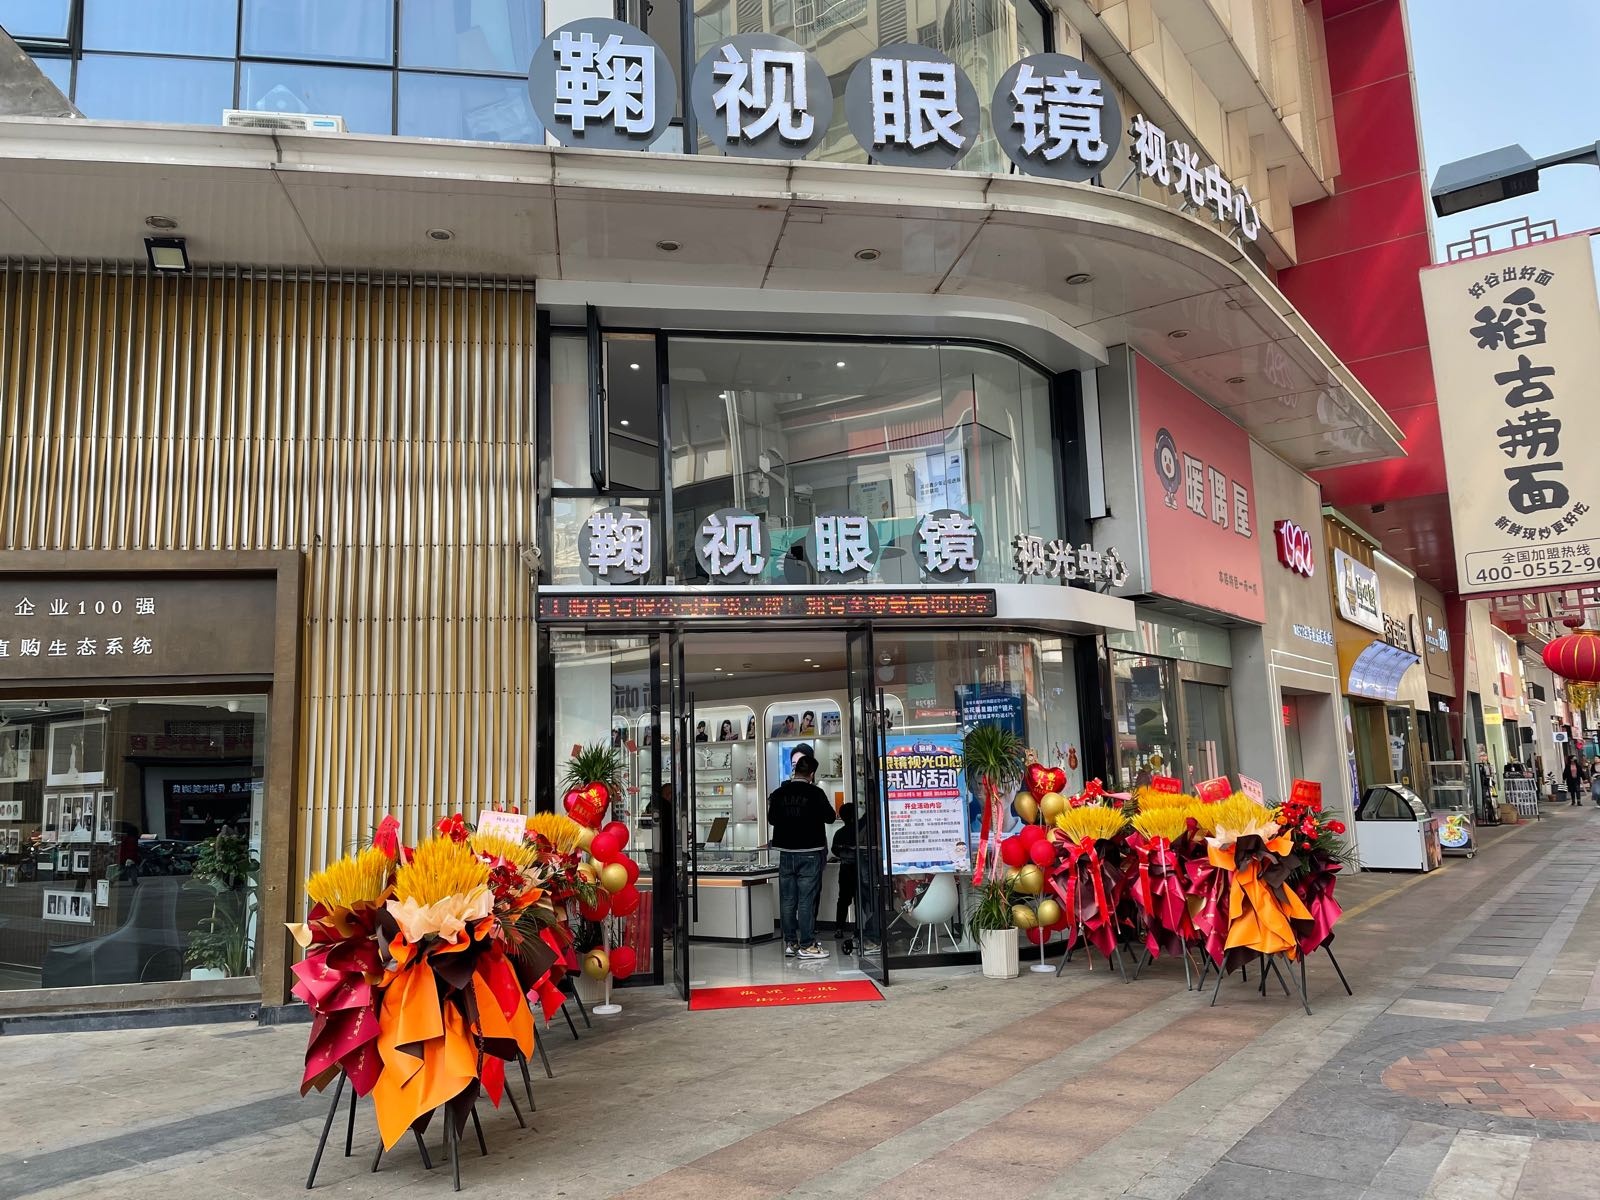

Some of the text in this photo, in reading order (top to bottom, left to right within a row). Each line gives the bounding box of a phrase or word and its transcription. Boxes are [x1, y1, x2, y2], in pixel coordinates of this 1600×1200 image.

[553, 31, 1261, 241] 鞠视眼镜 视光中心
[1468, 265, 1554, 299] 好谷出好面
[1469, 286, 1570, 515] 稻古捞面
[1494, 502, 1590, 540] 新鲜现炒更好吃
[588, 512, 1130, 587] 鞠视眼镜 视光中心
[1502, 544, 1591, 564] 全国加盟热线
[14, 597, 155, 616] 企业100强
[0, 637, 153, 657] 直购生态系统
[887, 769, 957, 789] 开业活动
